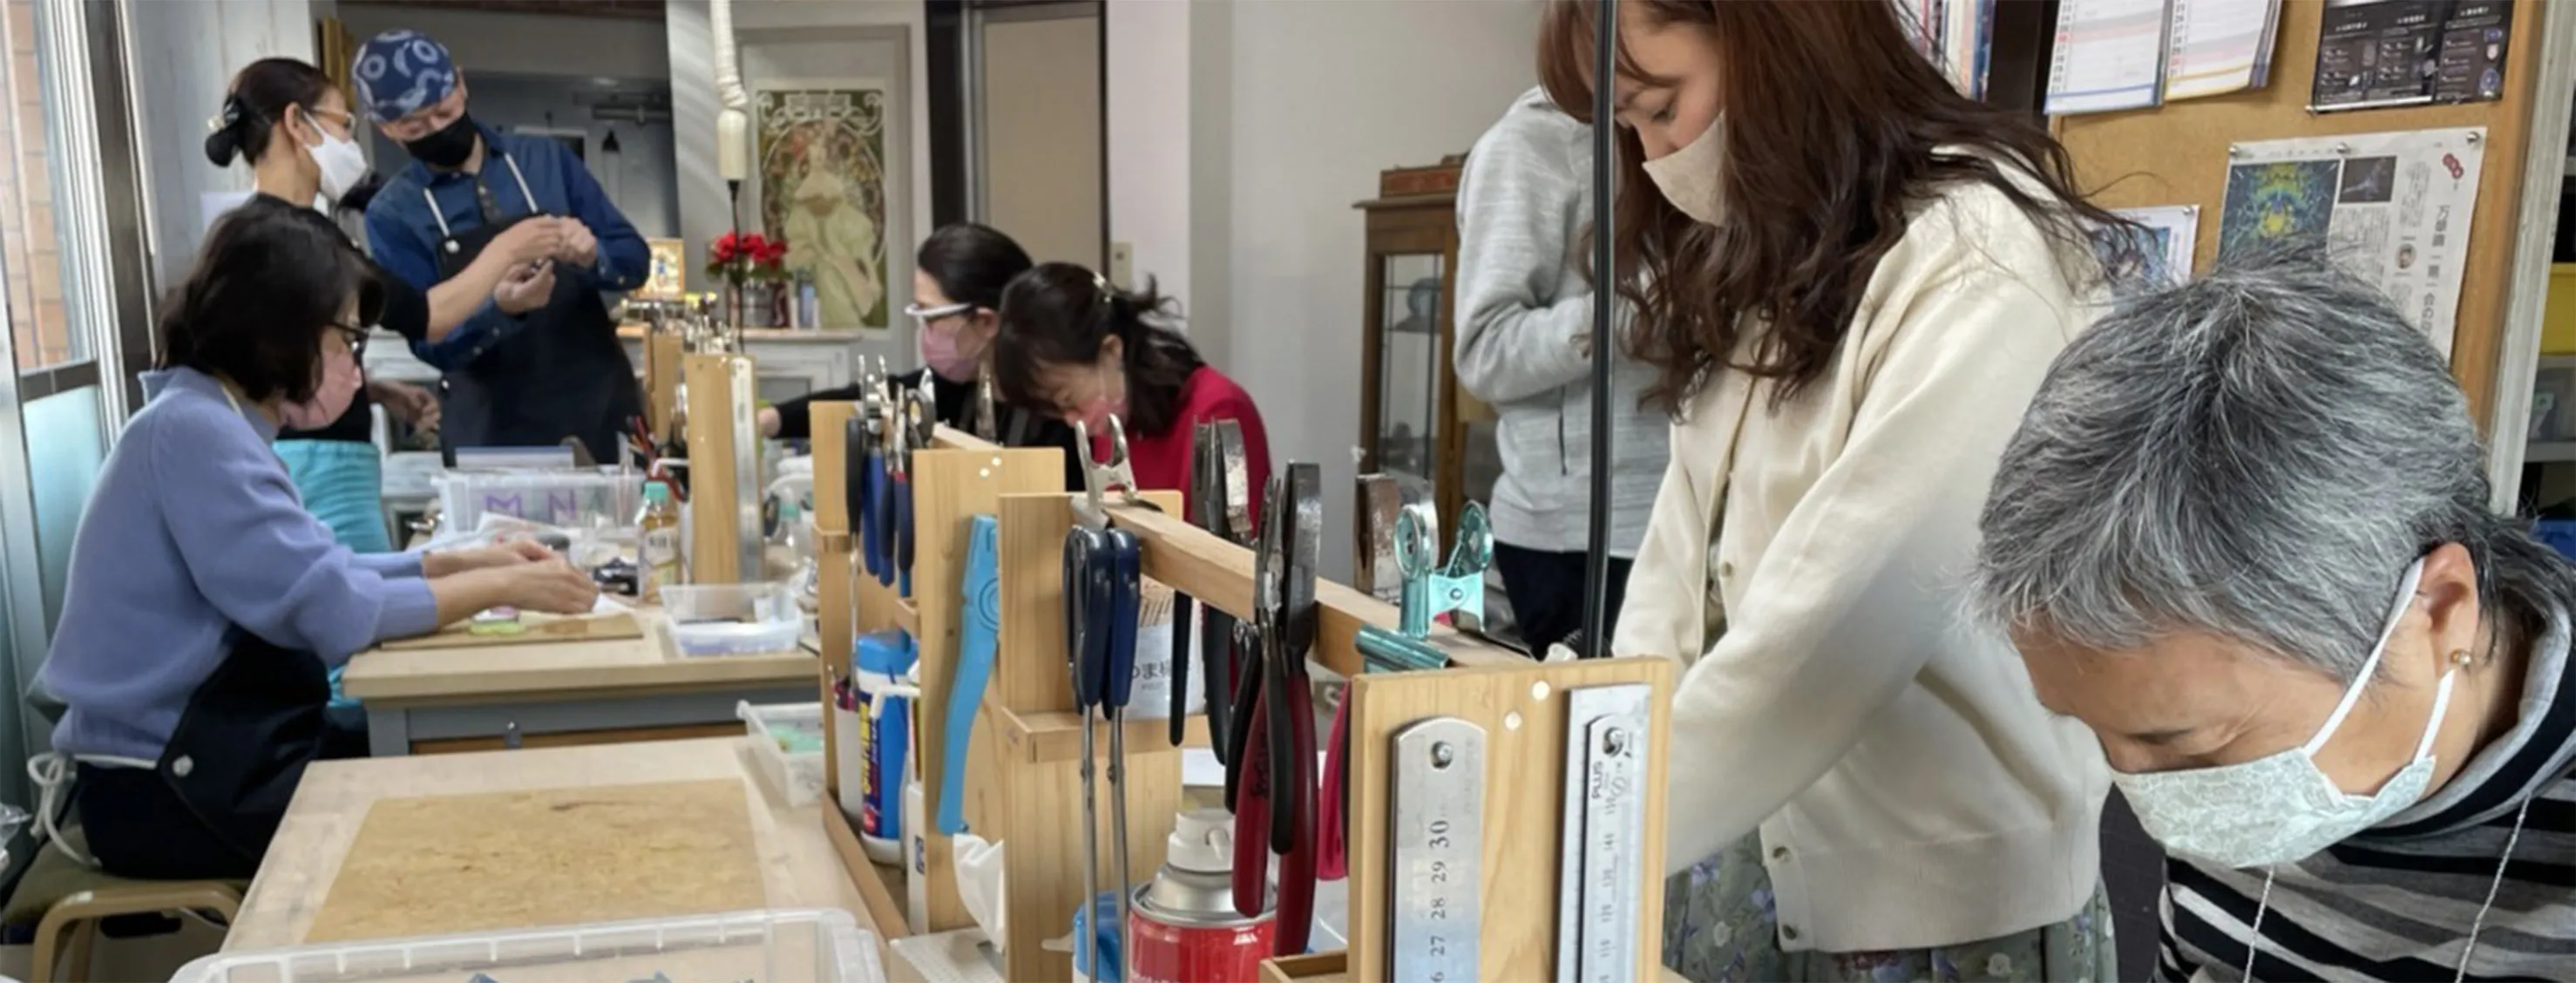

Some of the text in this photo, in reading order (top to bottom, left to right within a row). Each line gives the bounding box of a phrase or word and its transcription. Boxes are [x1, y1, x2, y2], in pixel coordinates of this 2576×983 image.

[1591, 761, 1603, 799] PLUS
[1429, 820, 1450, 849] 30
[1431, 861, 1447, 883] 29
[1431, 898, 1447, 919] 28
[1430, 935, 1446, 957] 27
